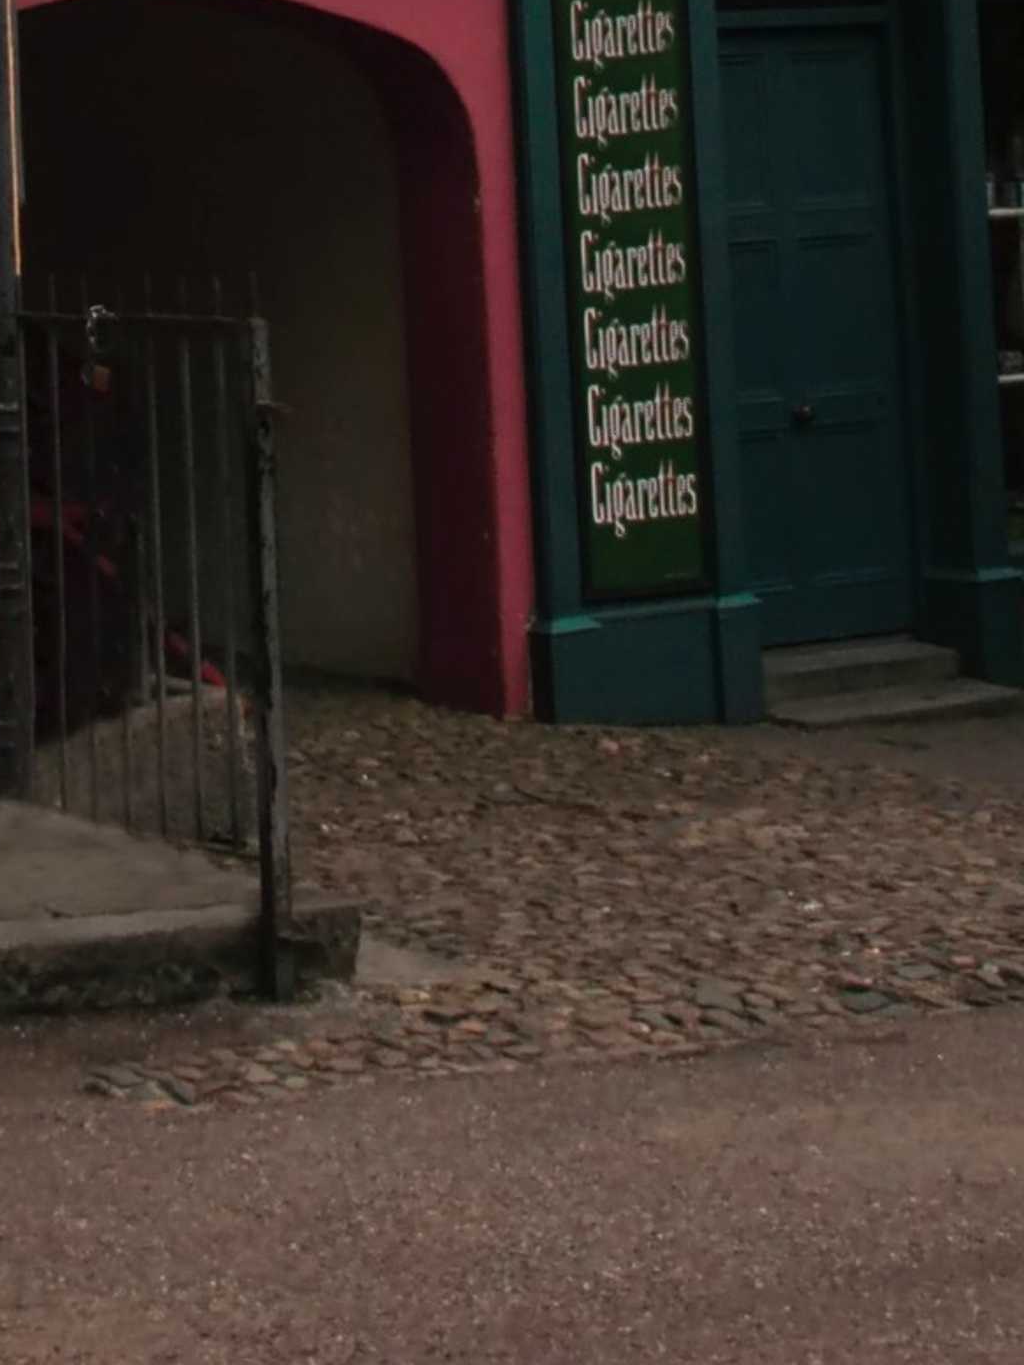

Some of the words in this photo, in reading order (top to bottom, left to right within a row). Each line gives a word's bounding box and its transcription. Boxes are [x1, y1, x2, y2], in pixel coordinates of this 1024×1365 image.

[574, 74, 677, 146] Cigarettes
[578, 152, 682, 224] Cigarettes
[581, 229, 685, 301] Cigarettes
[584, 305, 689, 378] Cigarettes
[587, 382, 693, 459] Cigarettes
[591, 460, 696, 538] Cigarettes
